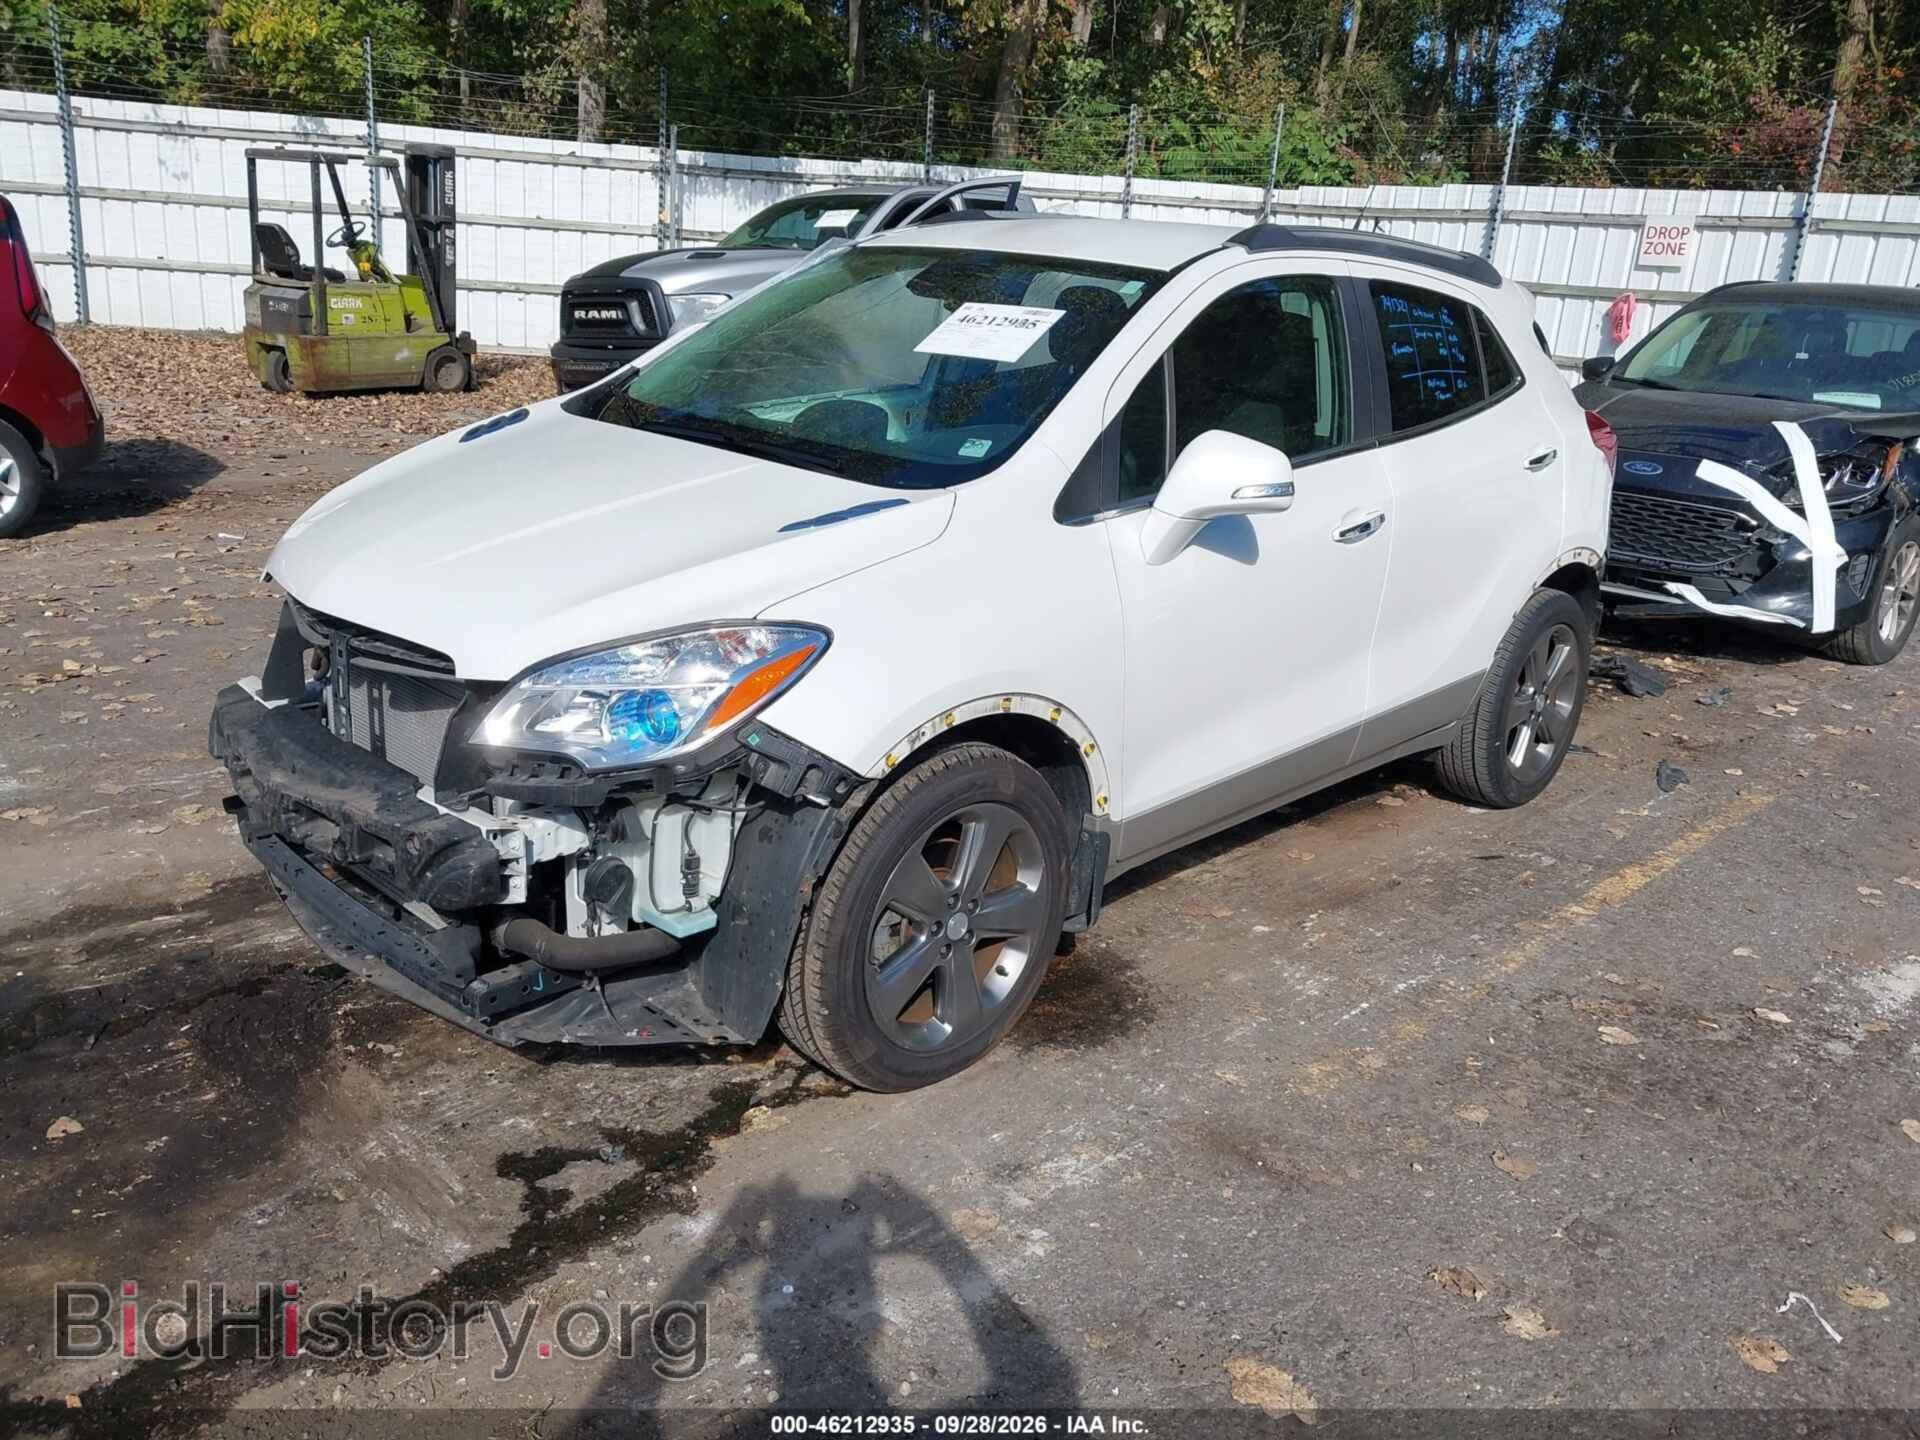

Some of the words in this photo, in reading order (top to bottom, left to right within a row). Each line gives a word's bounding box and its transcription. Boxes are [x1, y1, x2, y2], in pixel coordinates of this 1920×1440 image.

[445, 170, 454, 205] CLARK
[1646, 226, 1690, 240] DROP
[1643, 242, 1687, 256] ZONE
[330, 298, 362, 308] CLARK
[574, 310, 617, 319] RAM
